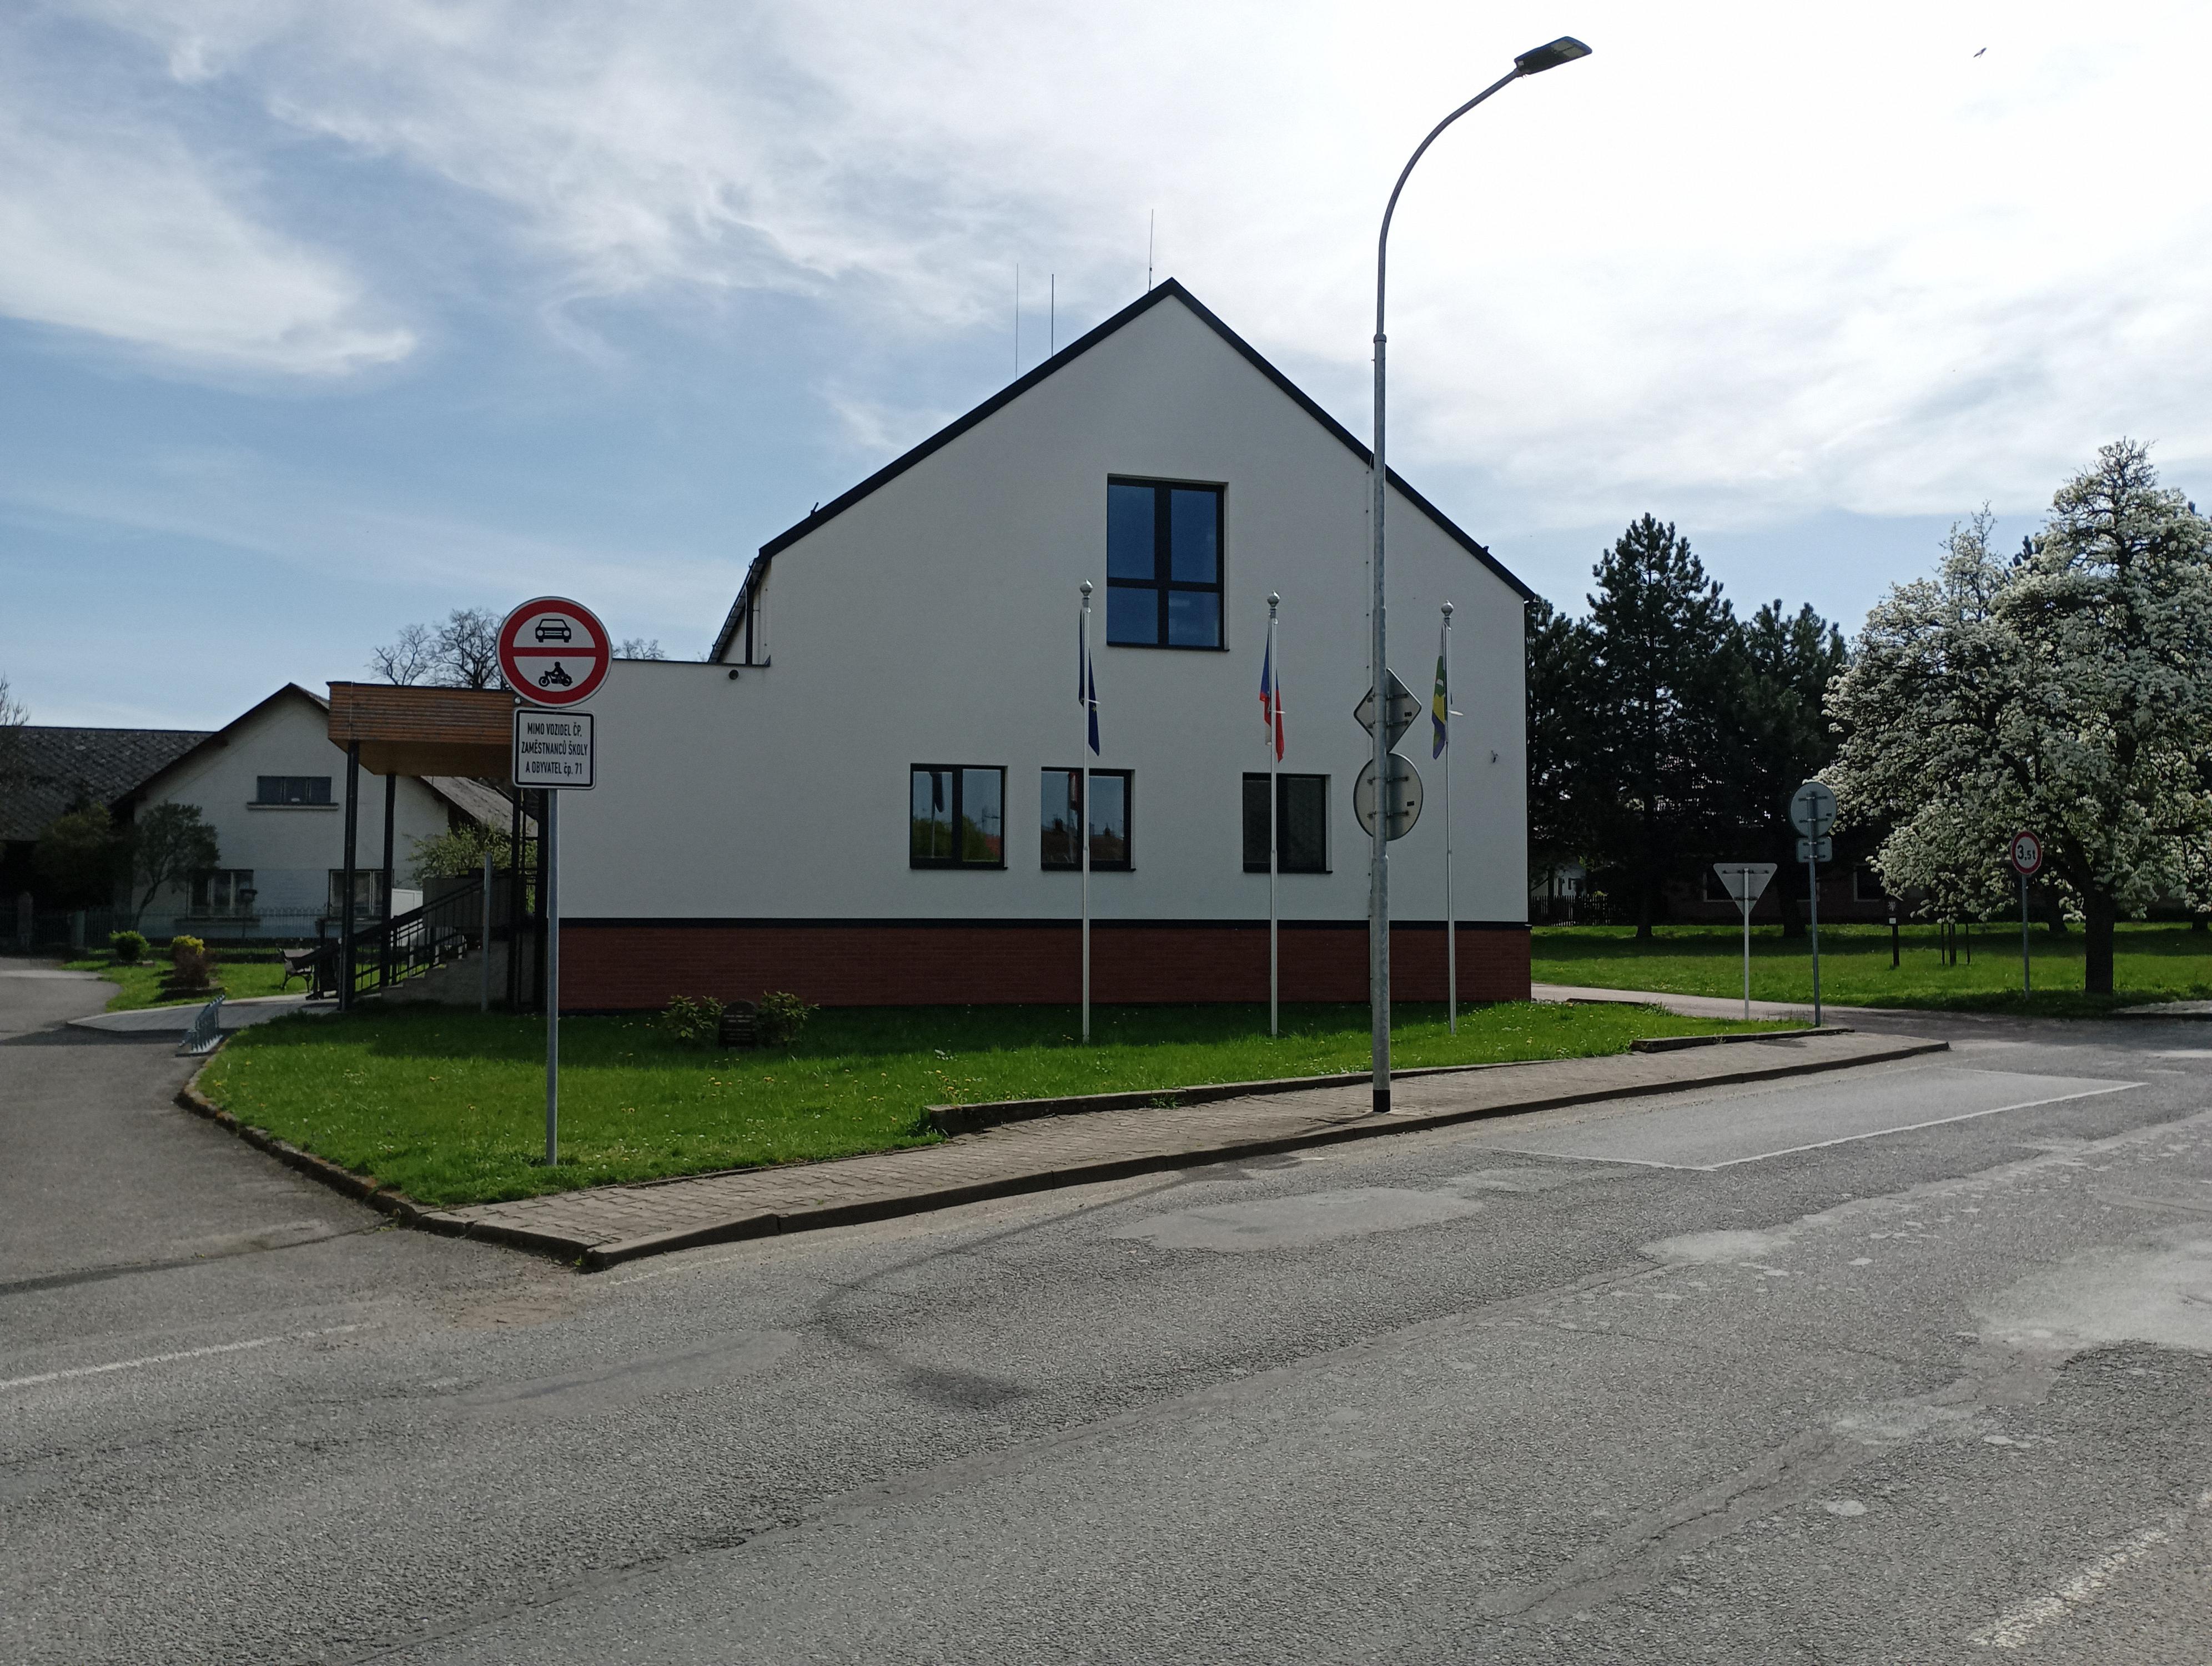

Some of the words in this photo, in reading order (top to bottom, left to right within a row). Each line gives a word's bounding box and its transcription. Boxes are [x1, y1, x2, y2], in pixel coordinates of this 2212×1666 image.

[527, 722, 545, 735] MIMO
[546, 724, 571, 736] VOZIDEL
[573, 722, 582, 737] ČP.
[521, 739, 566, 755] ZAMĚSTNANCŮ
[569, 740, 588, 755] ŠKOLY
[525, 761, 530, 773] A
[532, 761, 562, 774] OBYVATEL
[564, 762, 573, 777] čp.
[575, 762, 582, 775] 71
